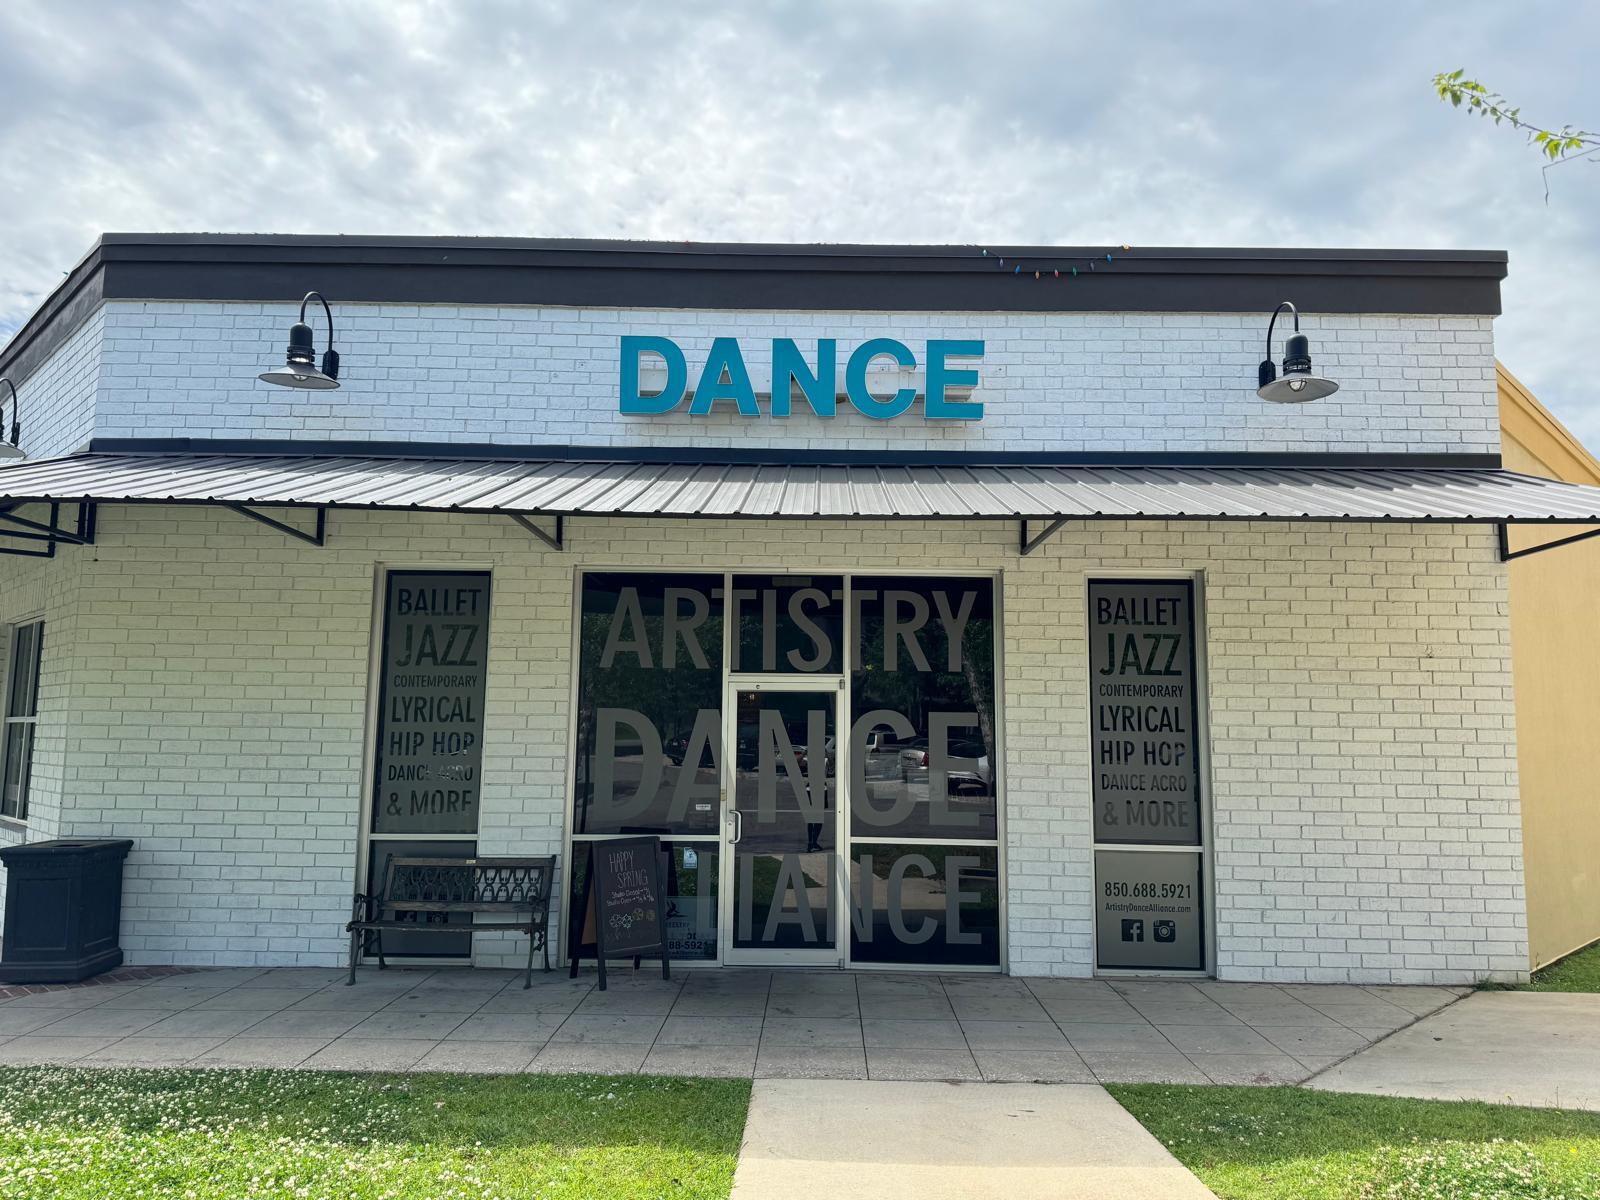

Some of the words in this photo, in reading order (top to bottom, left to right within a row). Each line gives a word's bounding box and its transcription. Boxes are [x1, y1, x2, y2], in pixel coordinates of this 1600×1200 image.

[619, 336, 985, 419] DANCE
[397, 588, 482, 617] BALLET
[1097, 597, 1181, 626] BALLET
[600, 586, 978, 673] ARTISTRY
[395, 624, 479, 666] JAZZ
[1100, 633, 1183, 676] JAZZ
[394, 675, 478, 688] CONTEMPORARY
[1099, 684, 1184, 698] CONTEMPORARY
[391, 696, 476, 723] LYRICAL
[1100, 705, 1185, 733] LYRICAL
[389, 732, 424, 756] HIP
[432, 732, 475, 756] HOP
[1100, 740, 1135, 766] HIP
[1143, 741, 1186, 767] HOP
[594, 707, 981, 827] DANCE
[1101, 773, 1146, 791] DANCE
[1151, 775, 1187, 792] ACRO
[386, 792, 402, 817] &
[410, 789, 472, 816] MORE
[1102, 801, 1118, 826] &
[1126, 800, 1189, 828] MORE
[609, 849, 634, 873] HAPPY
[617, 869, 648, 888] SPRING
[1104, 881, 1191, 899] 850.688.5921
[1105, 902, 1191, 913] ArtistryDanceAlliance.com
